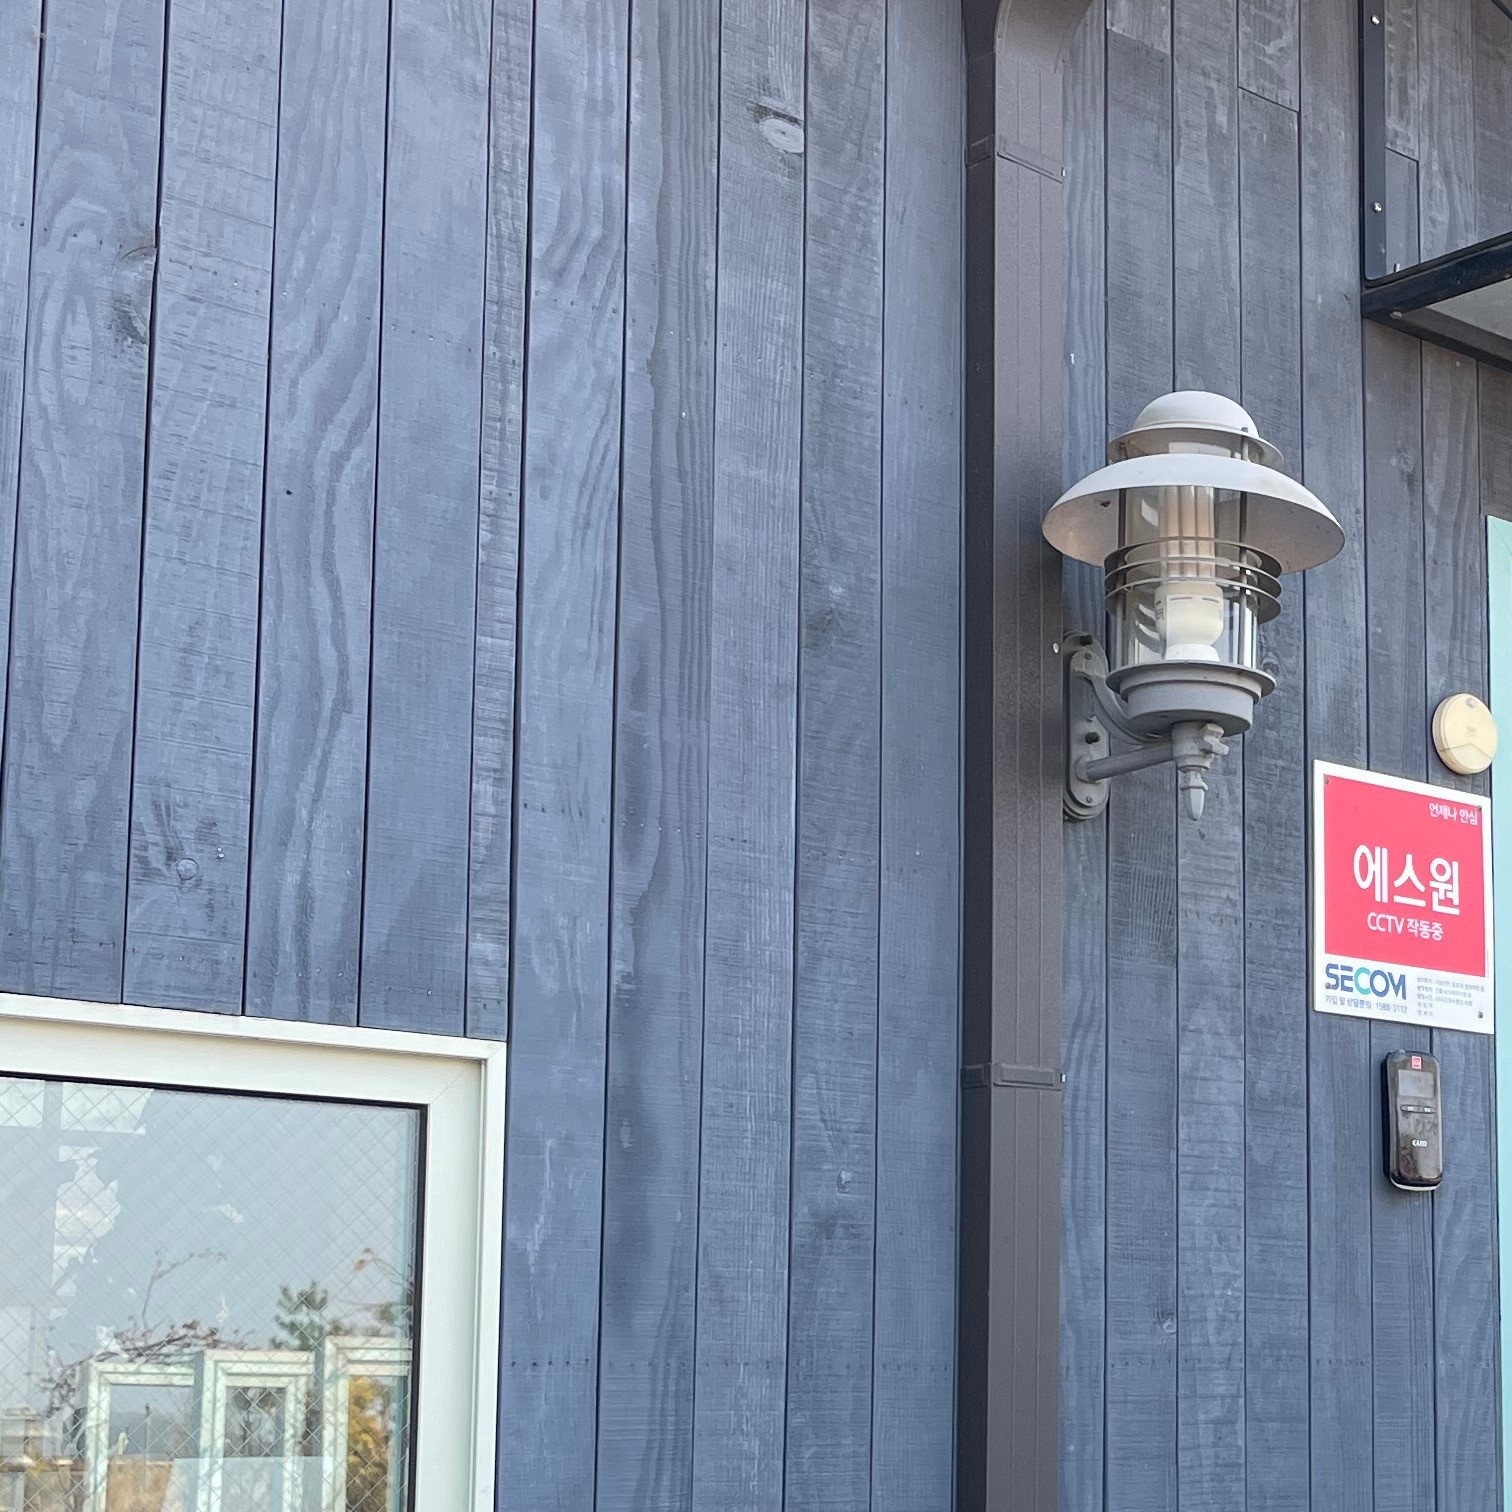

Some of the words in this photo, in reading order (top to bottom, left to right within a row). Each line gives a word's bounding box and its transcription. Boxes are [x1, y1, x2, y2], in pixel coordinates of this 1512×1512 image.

[1428, 802, 1457, 821] 언제나
[1459, 809, 1478, 826] 안심
[1353, 844, 1460, 915] 에스원
[1367, 912, 1404, 934] CCTV
[1406, 918, 1443, 941] 작동중
[1325, 963, 1407, 1000] SECOM
